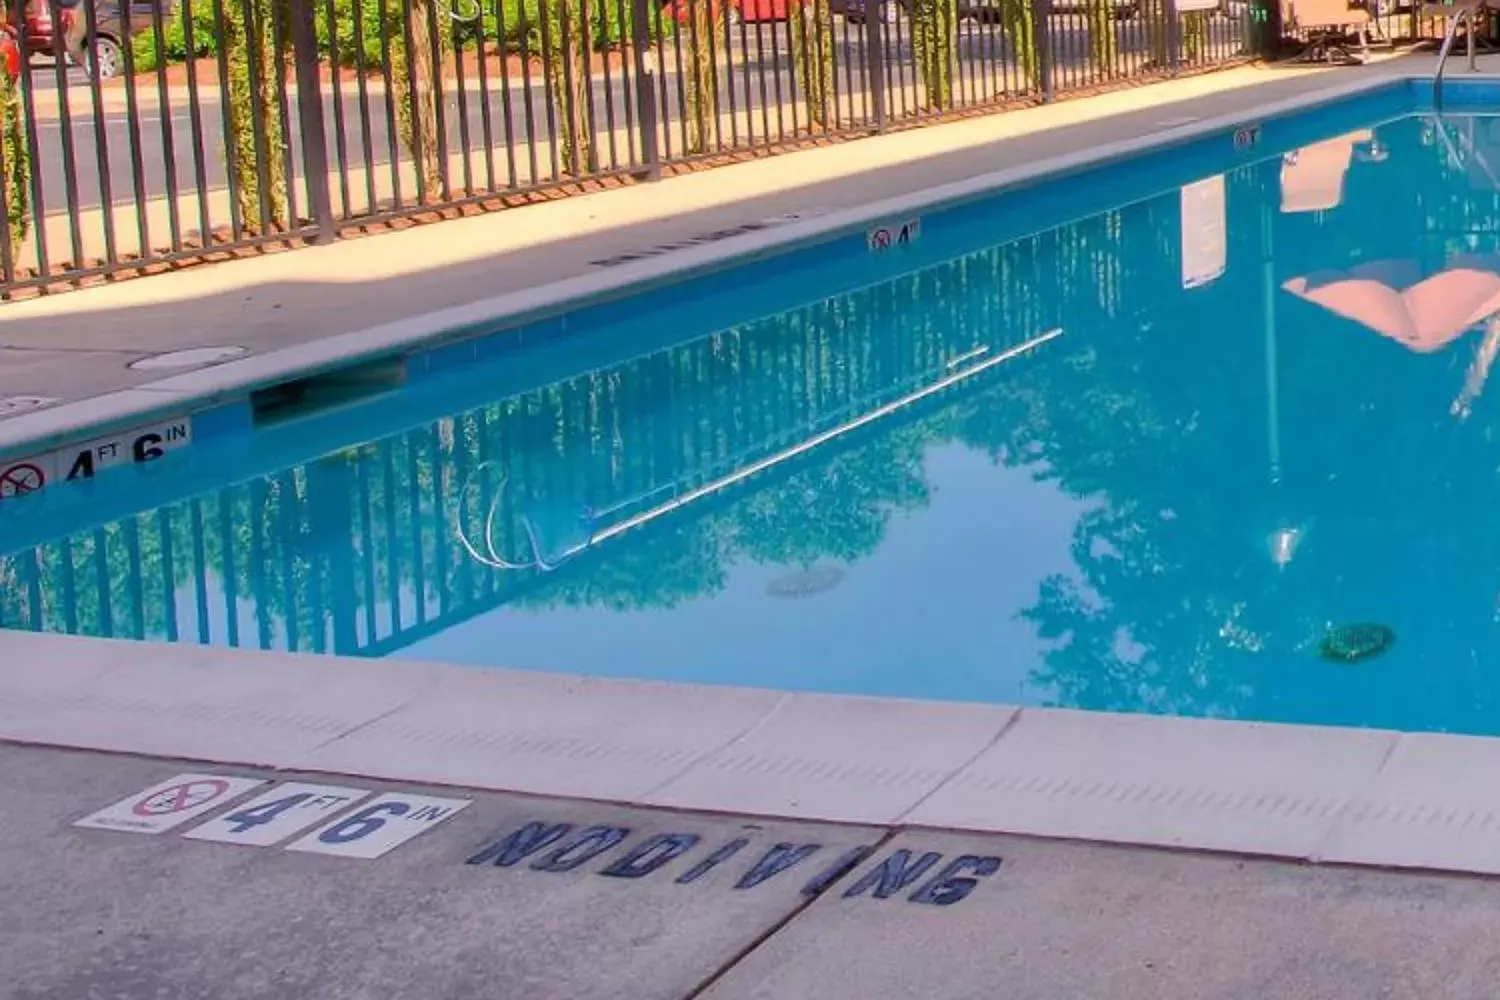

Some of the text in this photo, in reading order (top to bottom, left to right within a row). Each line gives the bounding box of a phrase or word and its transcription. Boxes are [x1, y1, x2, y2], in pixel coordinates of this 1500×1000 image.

[66, 423, 186, 481] 4 FT 6 IN
[223, 793, 316, 833] 4
[318, 802, 411, 844] 6
[406, 805, 452, 822] IN
